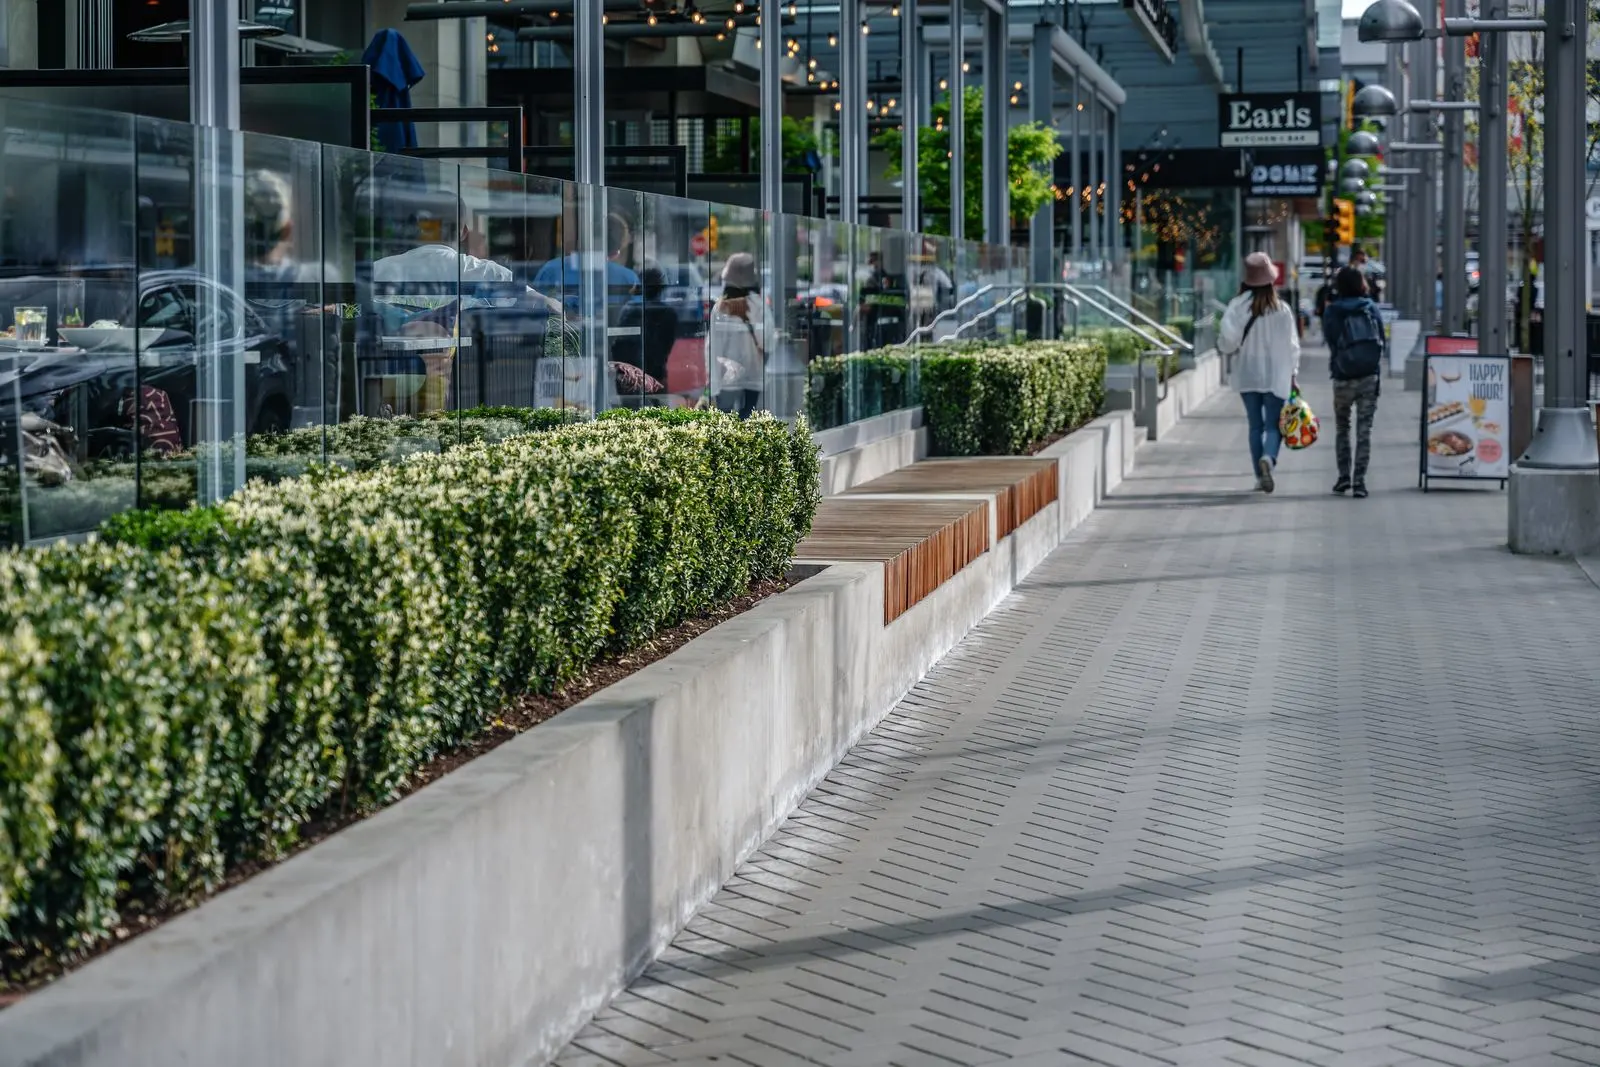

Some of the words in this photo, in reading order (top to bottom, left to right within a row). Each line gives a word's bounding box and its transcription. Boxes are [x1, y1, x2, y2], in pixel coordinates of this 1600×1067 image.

[1228, 99, 1312, 129] Earls
[1469, 363, 1504, 381] HAPPY
[1473, 382, 1503, 400] HOUR!
